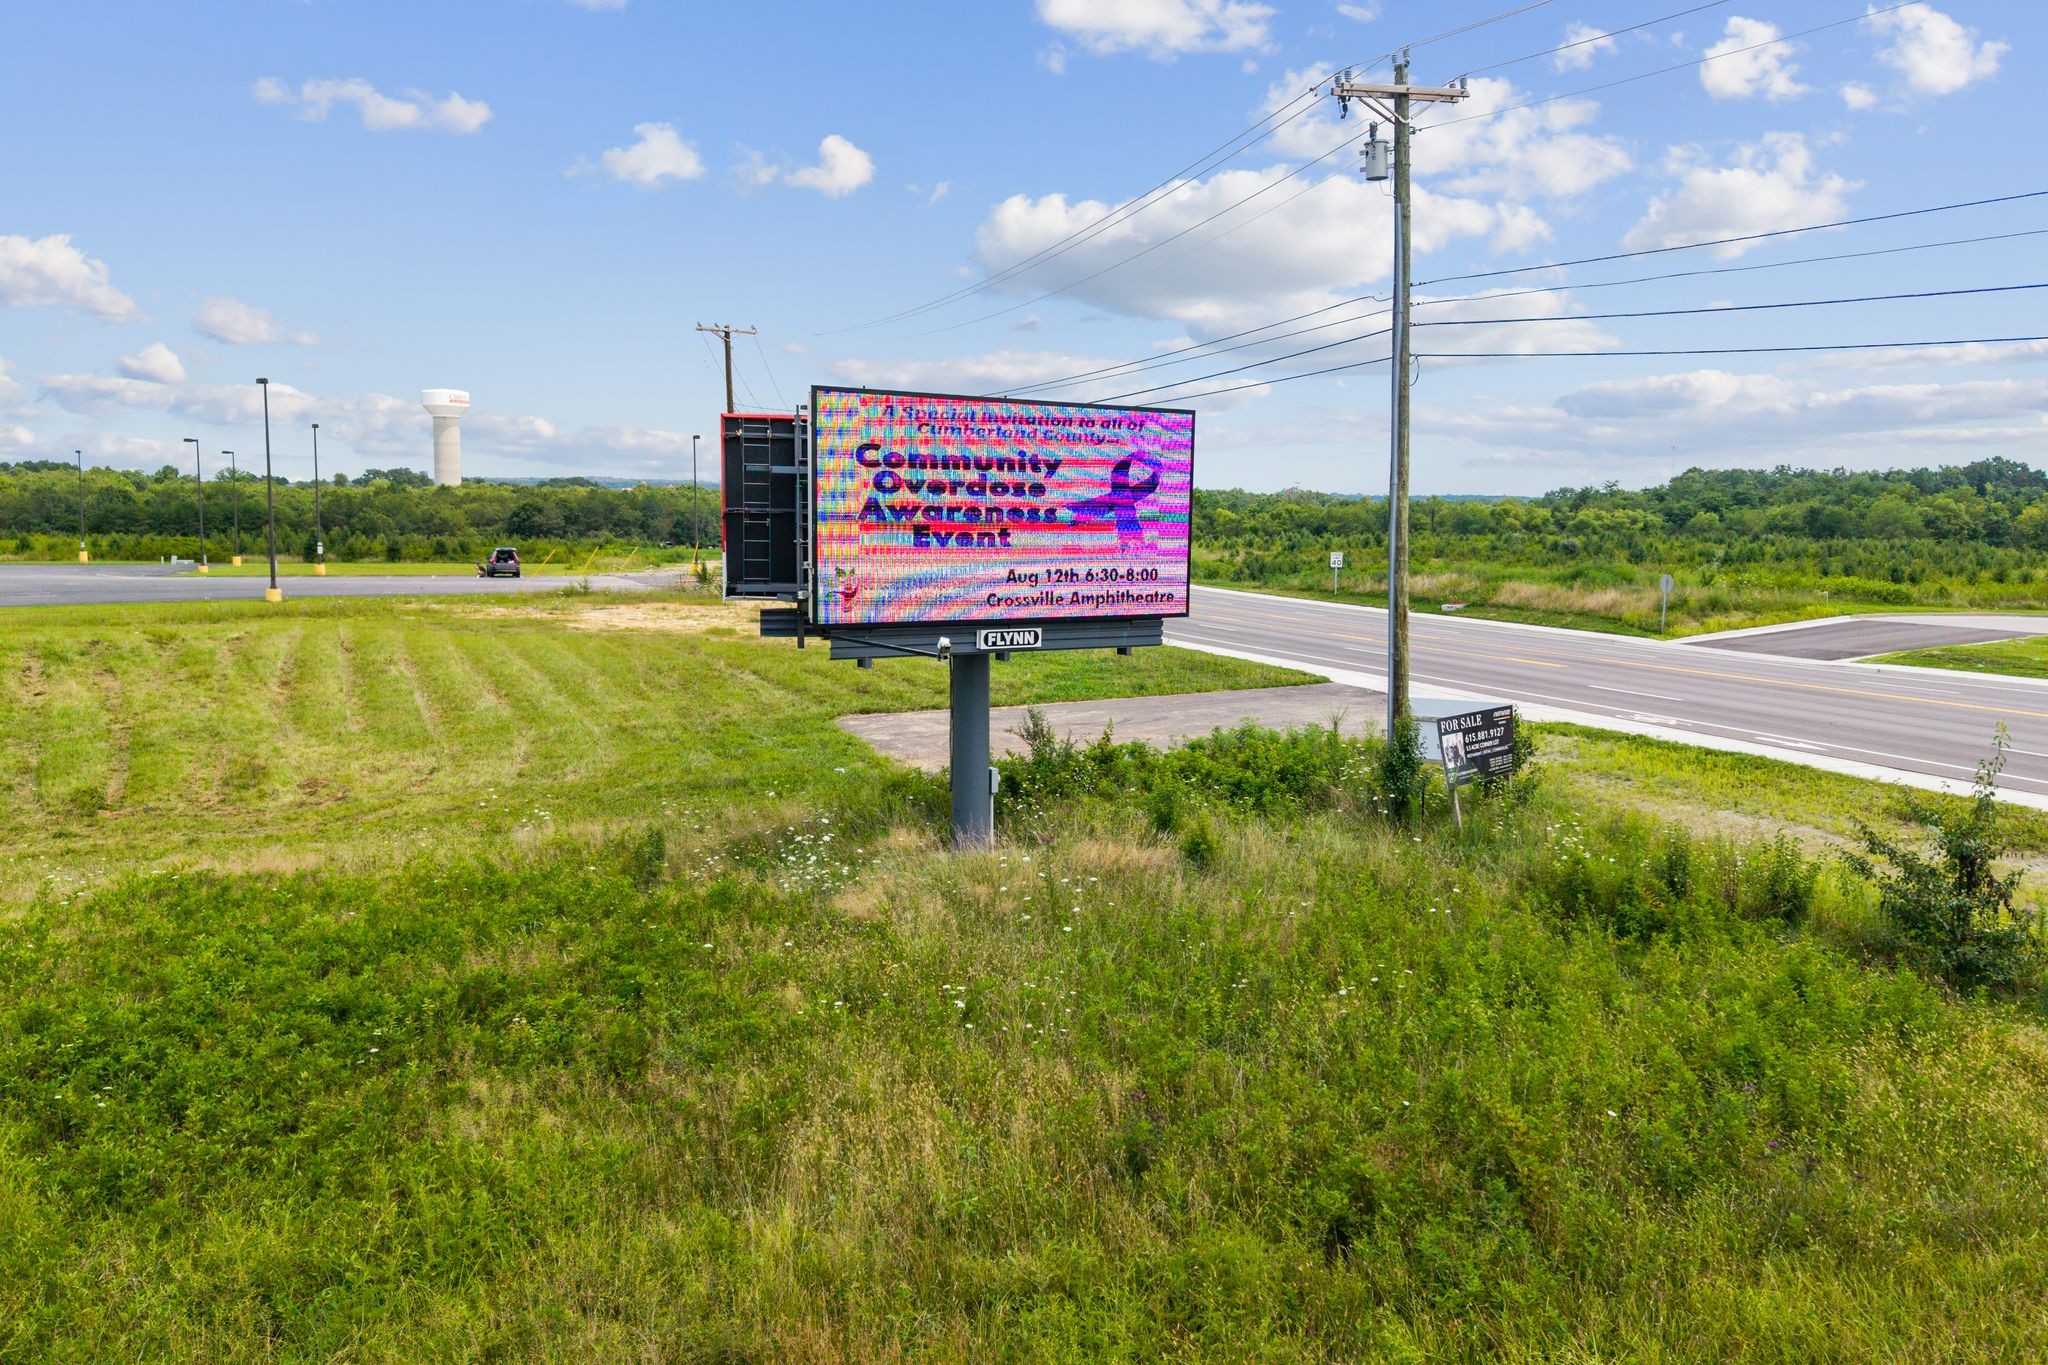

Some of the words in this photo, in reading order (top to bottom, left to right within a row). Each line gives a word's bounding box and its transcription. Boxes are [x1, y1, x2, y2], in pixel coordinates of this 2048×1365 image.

[902, 406, 976, 422] Special
[981, 411, 1074, 428] Invitation
[1079, 416, 1095, 428] to
[1100, 415, 1123, 429] all
[1127, 418, 1146, 432] of
[917, 422, 1037, 440] Cumberland
[856, 443, 1063, 479] Community
[873, 470, 1047, 498] Overdose
[858, 497, 1058, 523] Awareness
[912, 523, 1011, 548] Event
[1006, 569, 1039, 587] Aug
[1046, 568, 1080, 583] 12th
[1085, 567, 1158, 582] 6:30-8:00
[986, 591, 1064, 607] Crossville
[1069, 589, 1174, 609] Amphitheatre
[987, 630, 1035, 646] FLYNN
[1440, 719, 1459, 733] FOR
[1460, 714, 1482, 729] SALE
